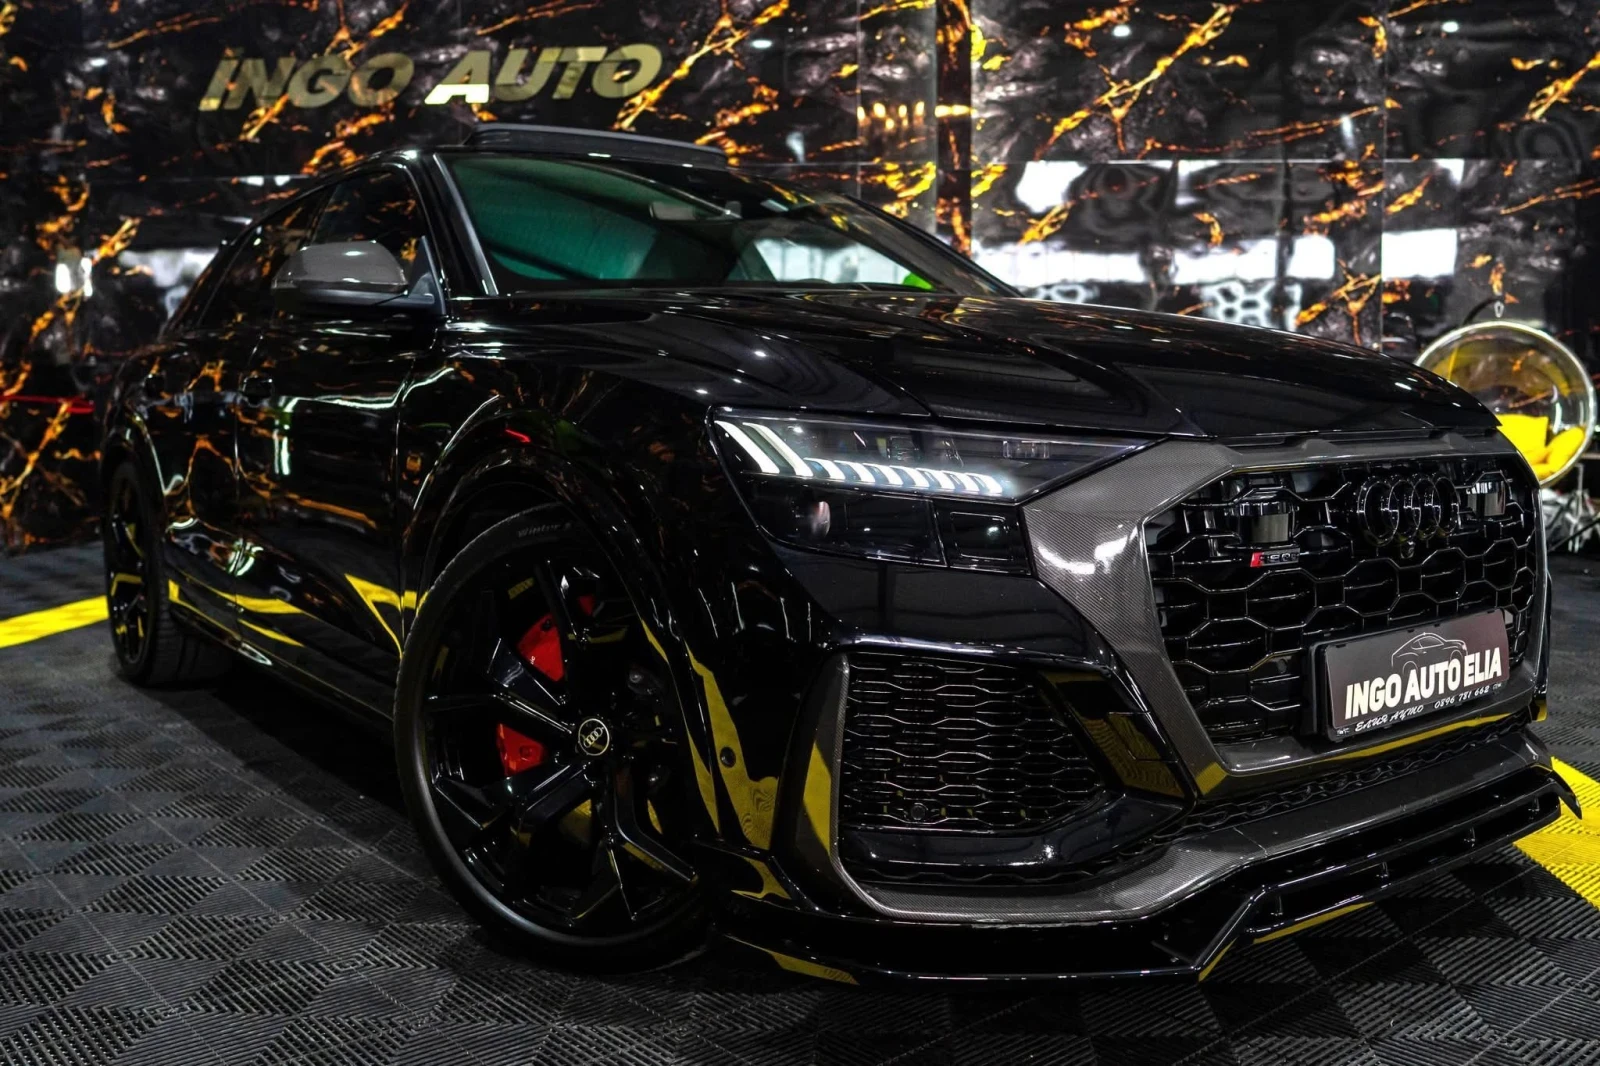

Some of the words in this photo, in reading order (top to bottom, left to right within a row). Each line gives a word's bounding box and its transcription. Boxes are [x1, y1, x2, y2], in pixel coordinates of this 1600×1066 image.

[424, 43, 662, 104] AUTO
[1345, 673, 1402, 720] INGO
[1403, 658, 1461, 704] AUTO
[1463, 647, 1502, 687] ELIA
